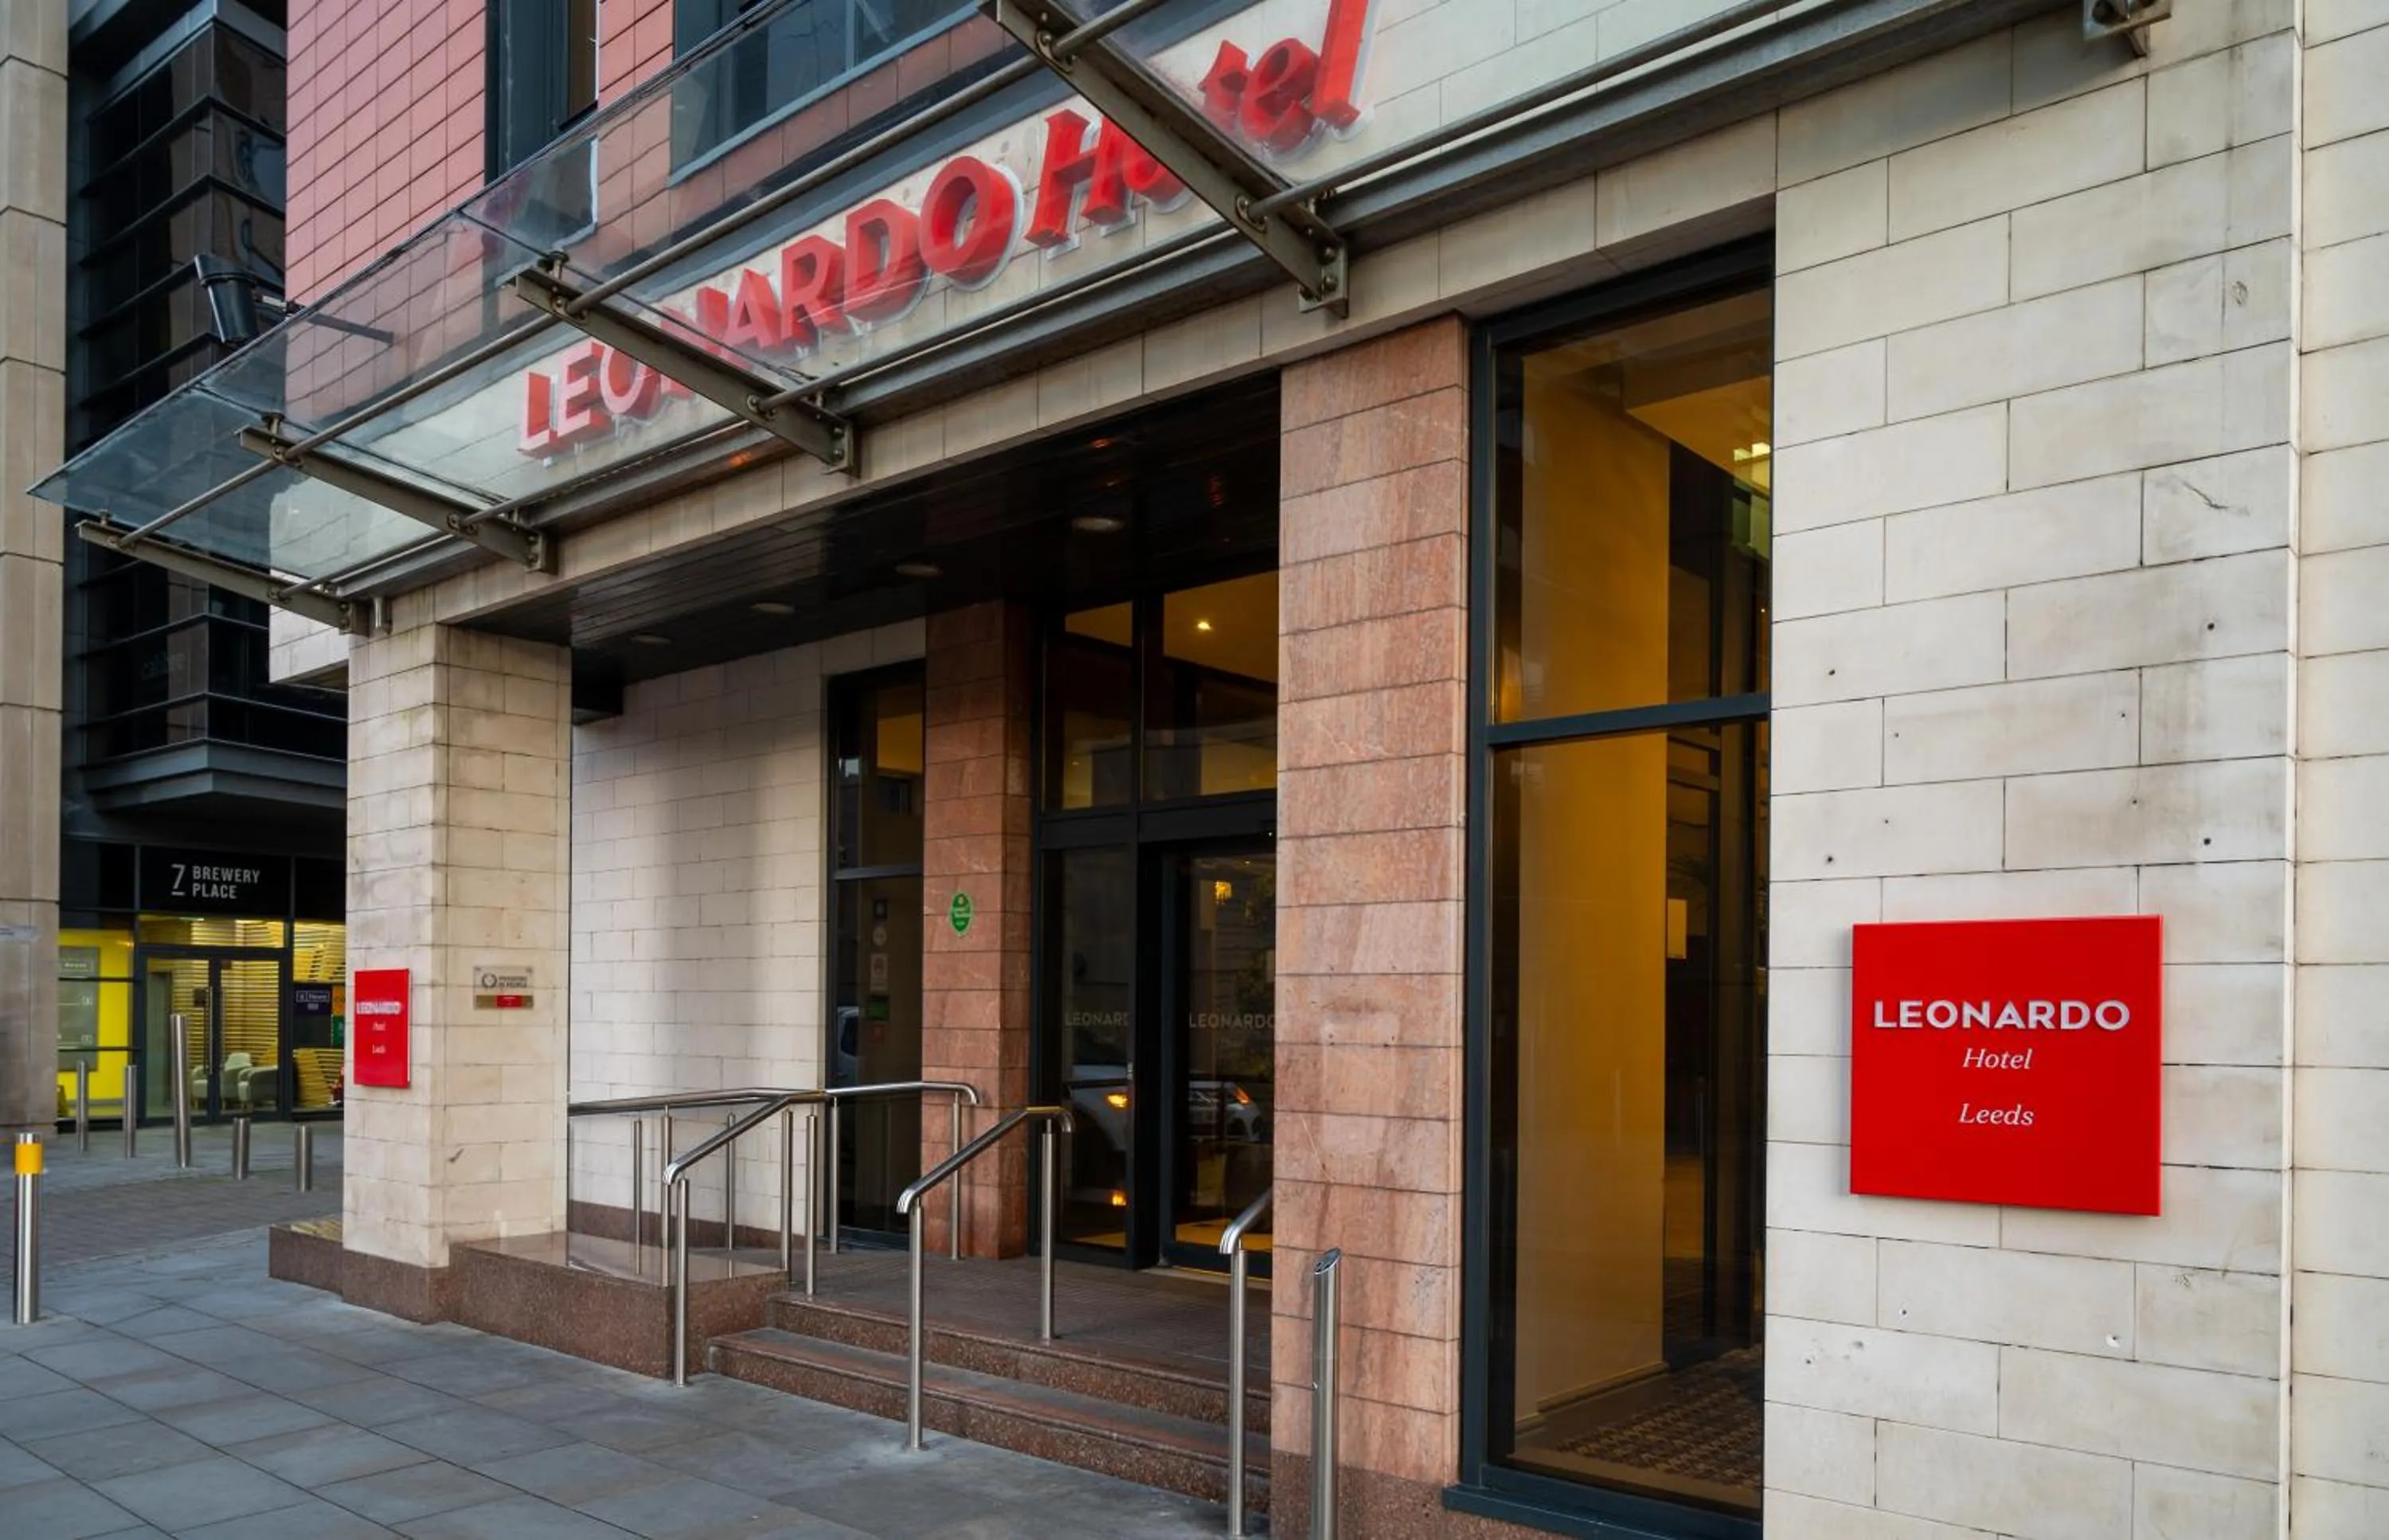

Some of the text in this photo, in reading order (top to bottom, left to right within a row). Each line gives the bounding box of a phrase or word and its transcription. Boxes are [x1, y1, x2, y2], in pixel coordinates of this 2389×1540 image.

[171, 864, 260, 890] 7 BREWERY
[193, 882, 237, 899] PLACE
[1874, 1000, 2130, 1030] LEONARDO
[1962, 1048, 2032, 1069] Hotel
[1959, 1104, 2034, 1125] Leeds
